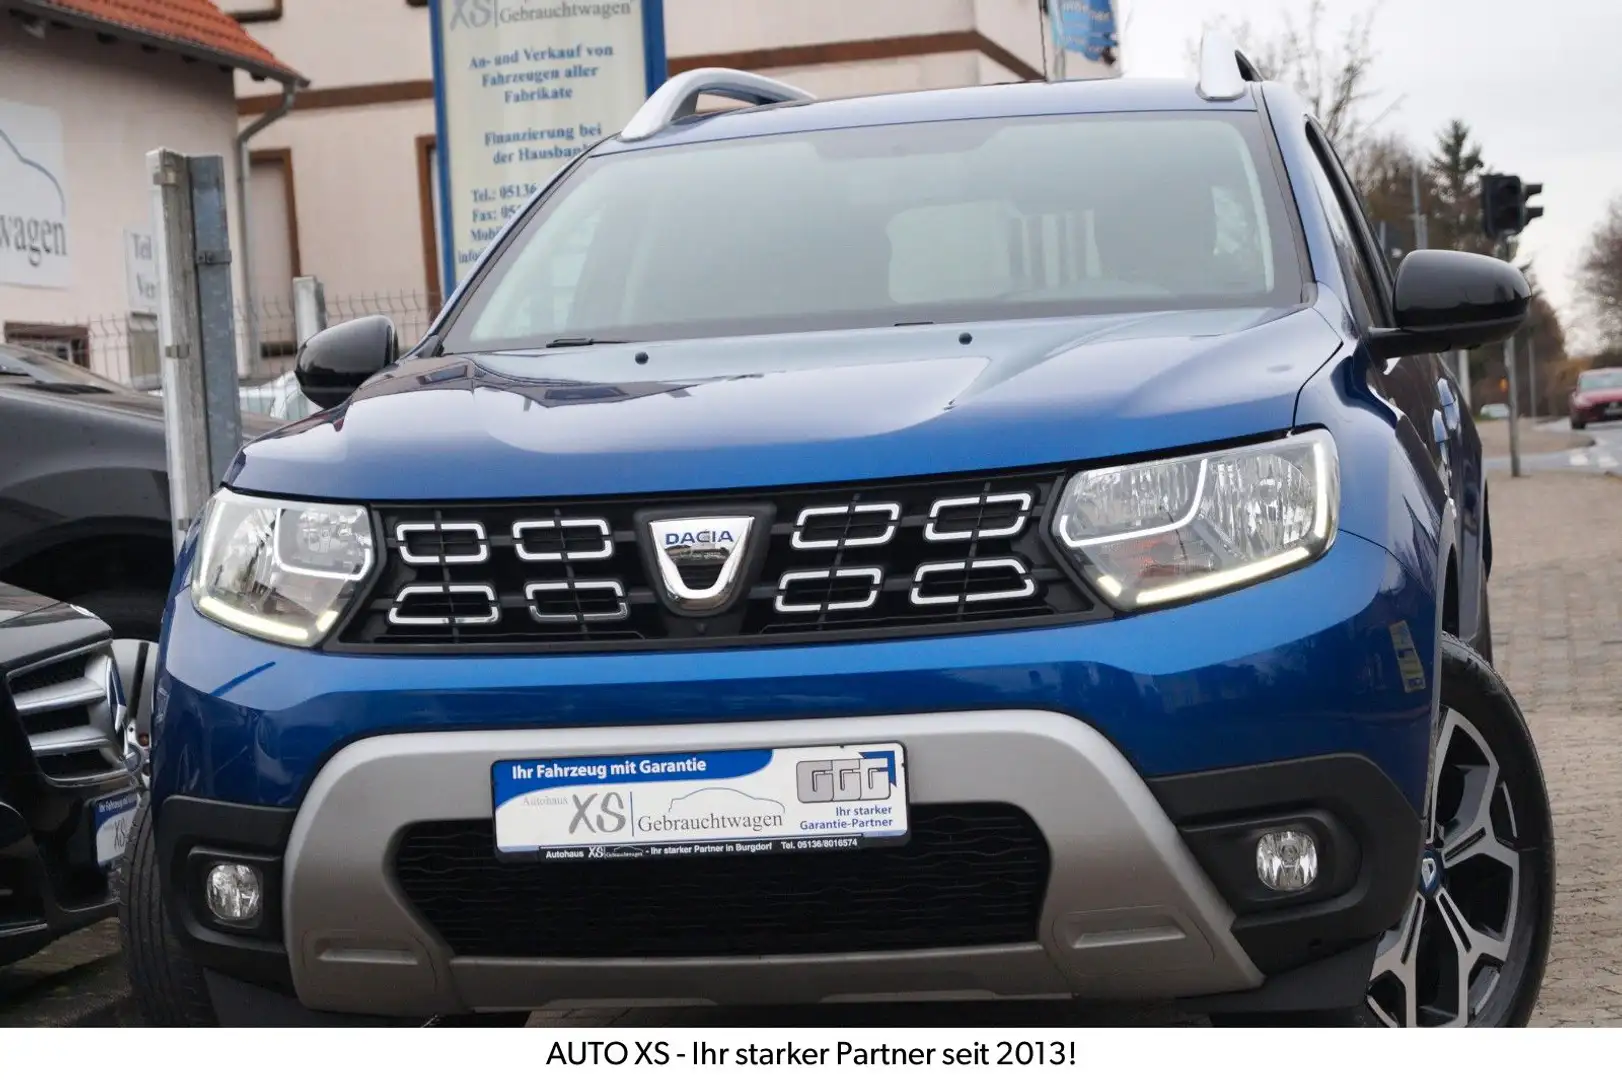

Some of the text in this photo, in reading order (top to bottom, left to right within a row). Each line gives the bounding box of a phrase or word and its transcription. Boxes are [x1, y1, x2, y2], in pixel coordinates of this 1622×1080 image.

[499, 0, 632, 25] Gebrauchtwagen
[469, 43, 614, 71] An- und Verkauf von
[481, 64, 599, 88] Fahrzeugen aller
[504, 86, 574, 104] Fabrikate
[484, 121, 602, 147] Finanzierung bei
[493, 149, 515, 166] der
[665, 530, 734, 545] DACIA
[512, 757, 707, 780] Ihr Fahrzeug mit Garantie
[522, 791, 627, 835] Autohaus XS
[836, 804, 893, 818] Ihr starker
[637, 812, 784, 833] Gebrauchtwagen
[800, 816, 894, 831] Garantie-Partner
[545, 849, 585, 860] Autohaus
[650, 846, 662, 855] Ihr
[664, 845, 692, 855] starker
[694, 844, 724, 854] Partner
[726, 843, 734, 853] in
[736, 841, 773, 853] Burgdorf
[781, 840, 796, 850] Tel.
